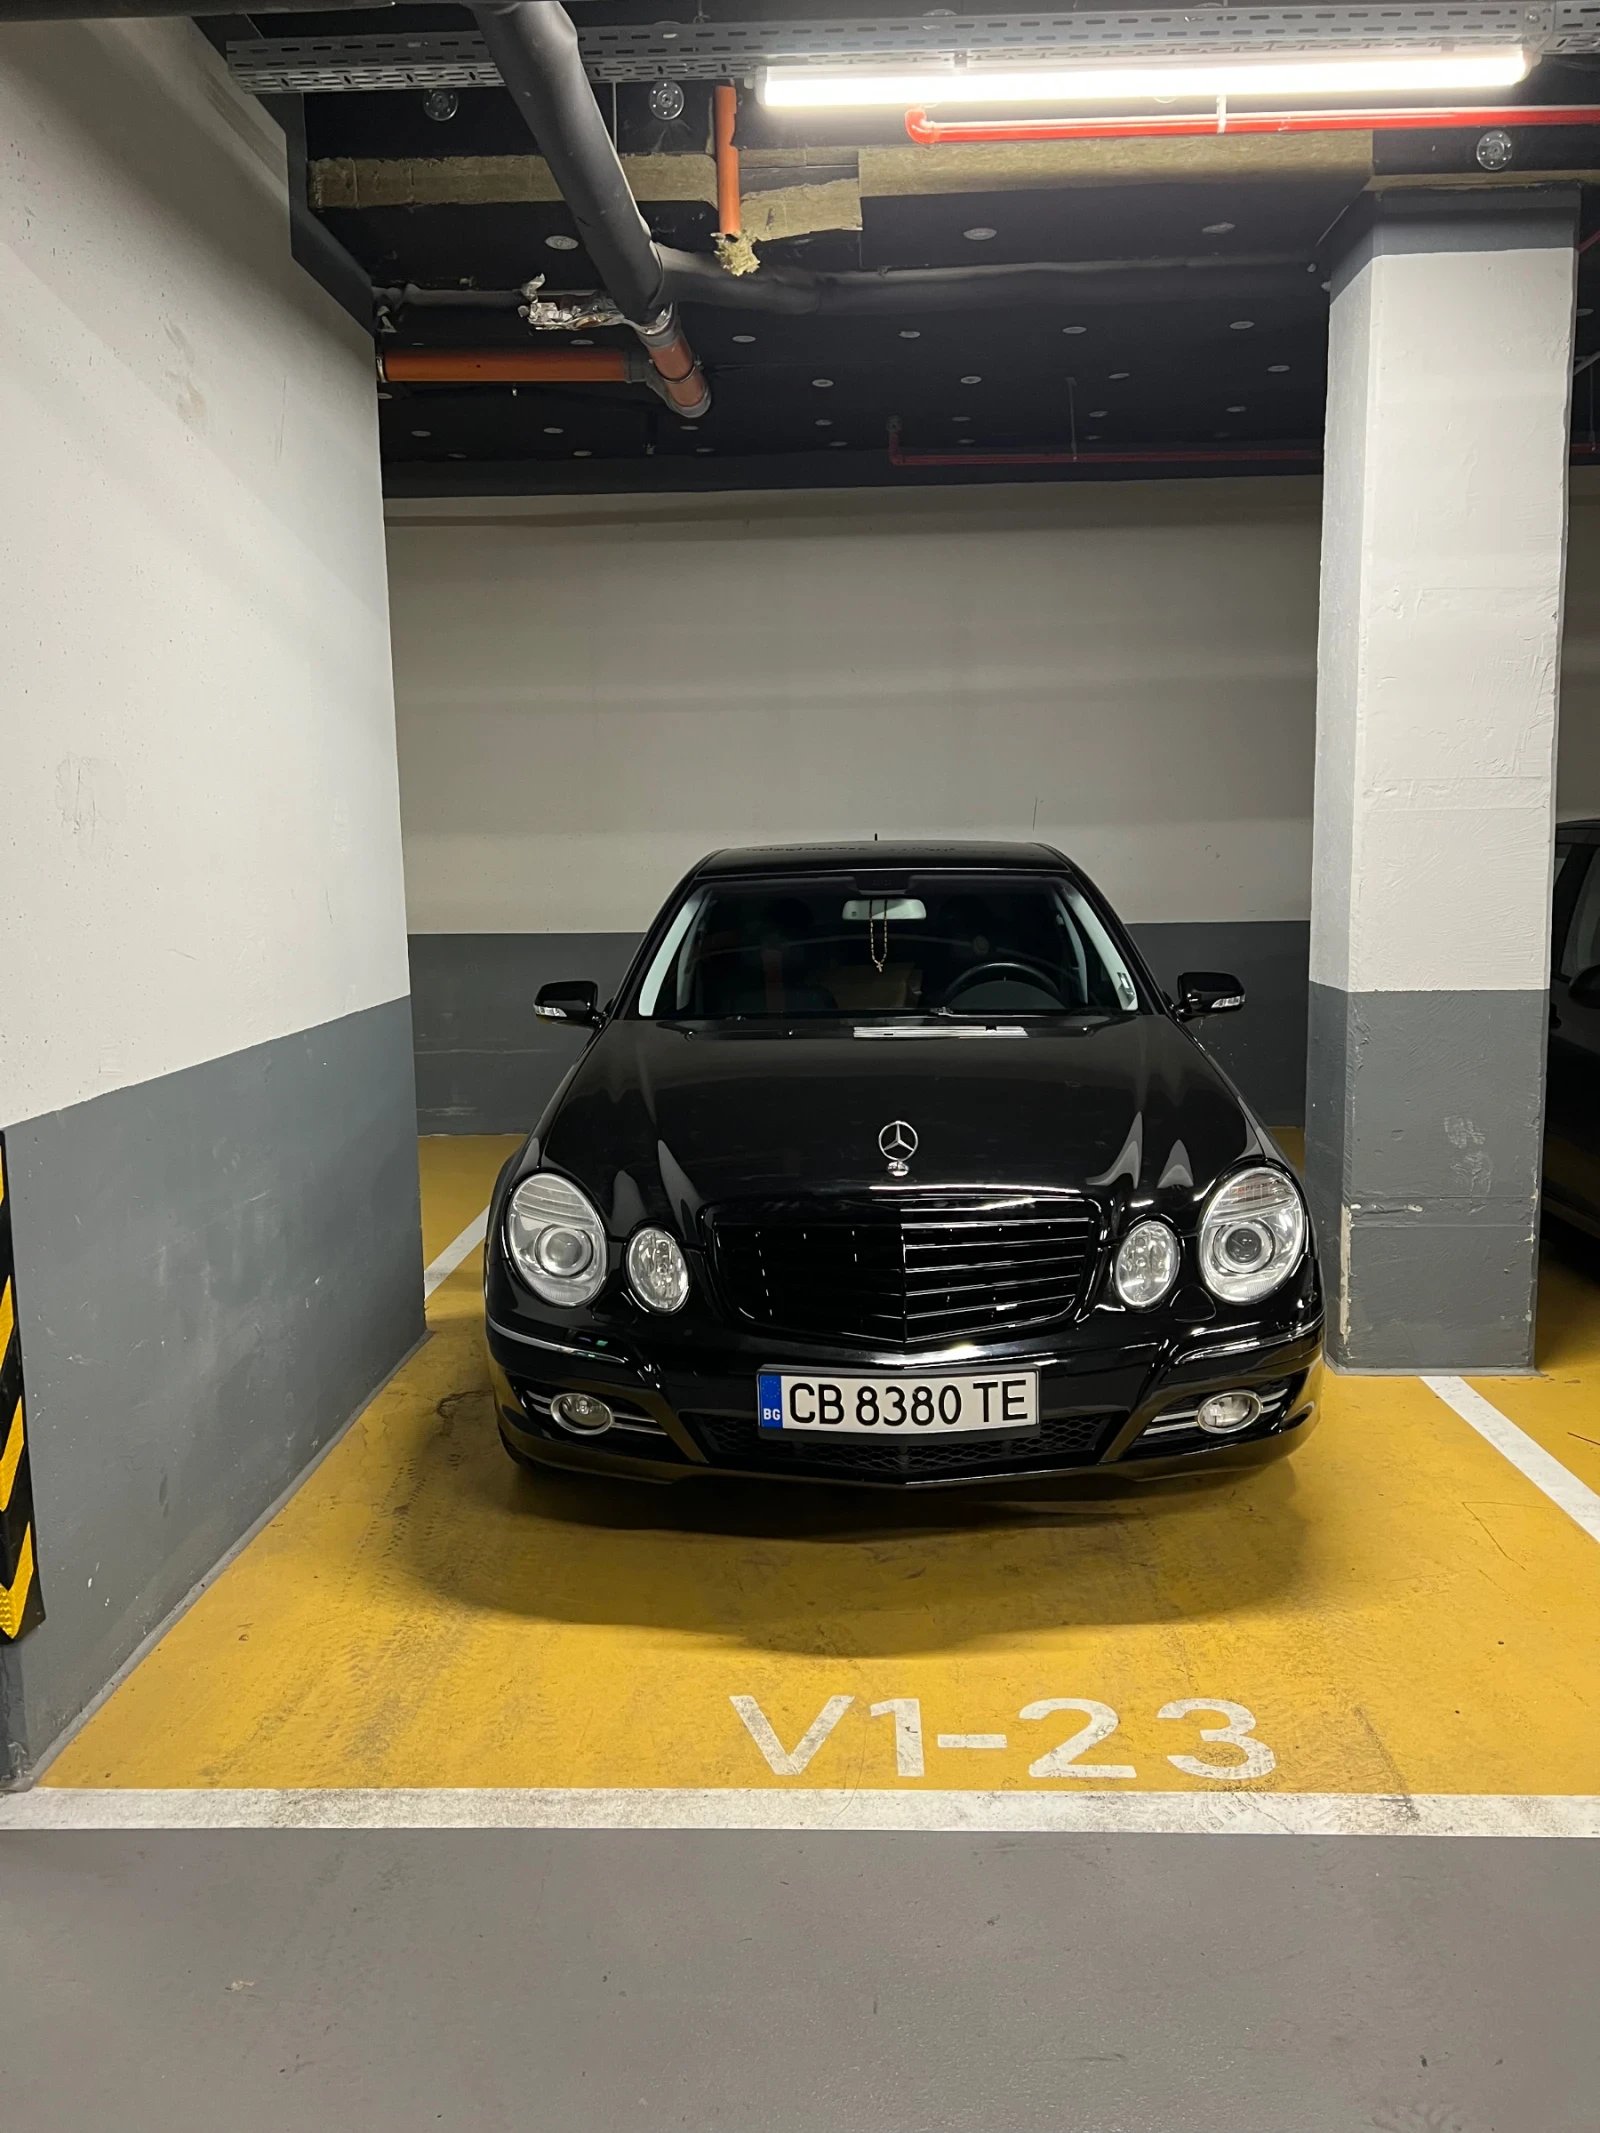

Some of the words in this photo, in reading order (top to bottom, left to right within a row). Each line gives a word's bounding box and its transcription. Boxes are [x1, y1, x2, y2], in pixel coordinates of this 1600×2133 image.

[763, 1408, 781, 1420] BG
[789, 1383, 845, 1425] CB
[855, 1385, 962, 1426] 8380
[973, 1379, 1028, 1423] TE
[729, 1695, 1276, 1780] V1-23
